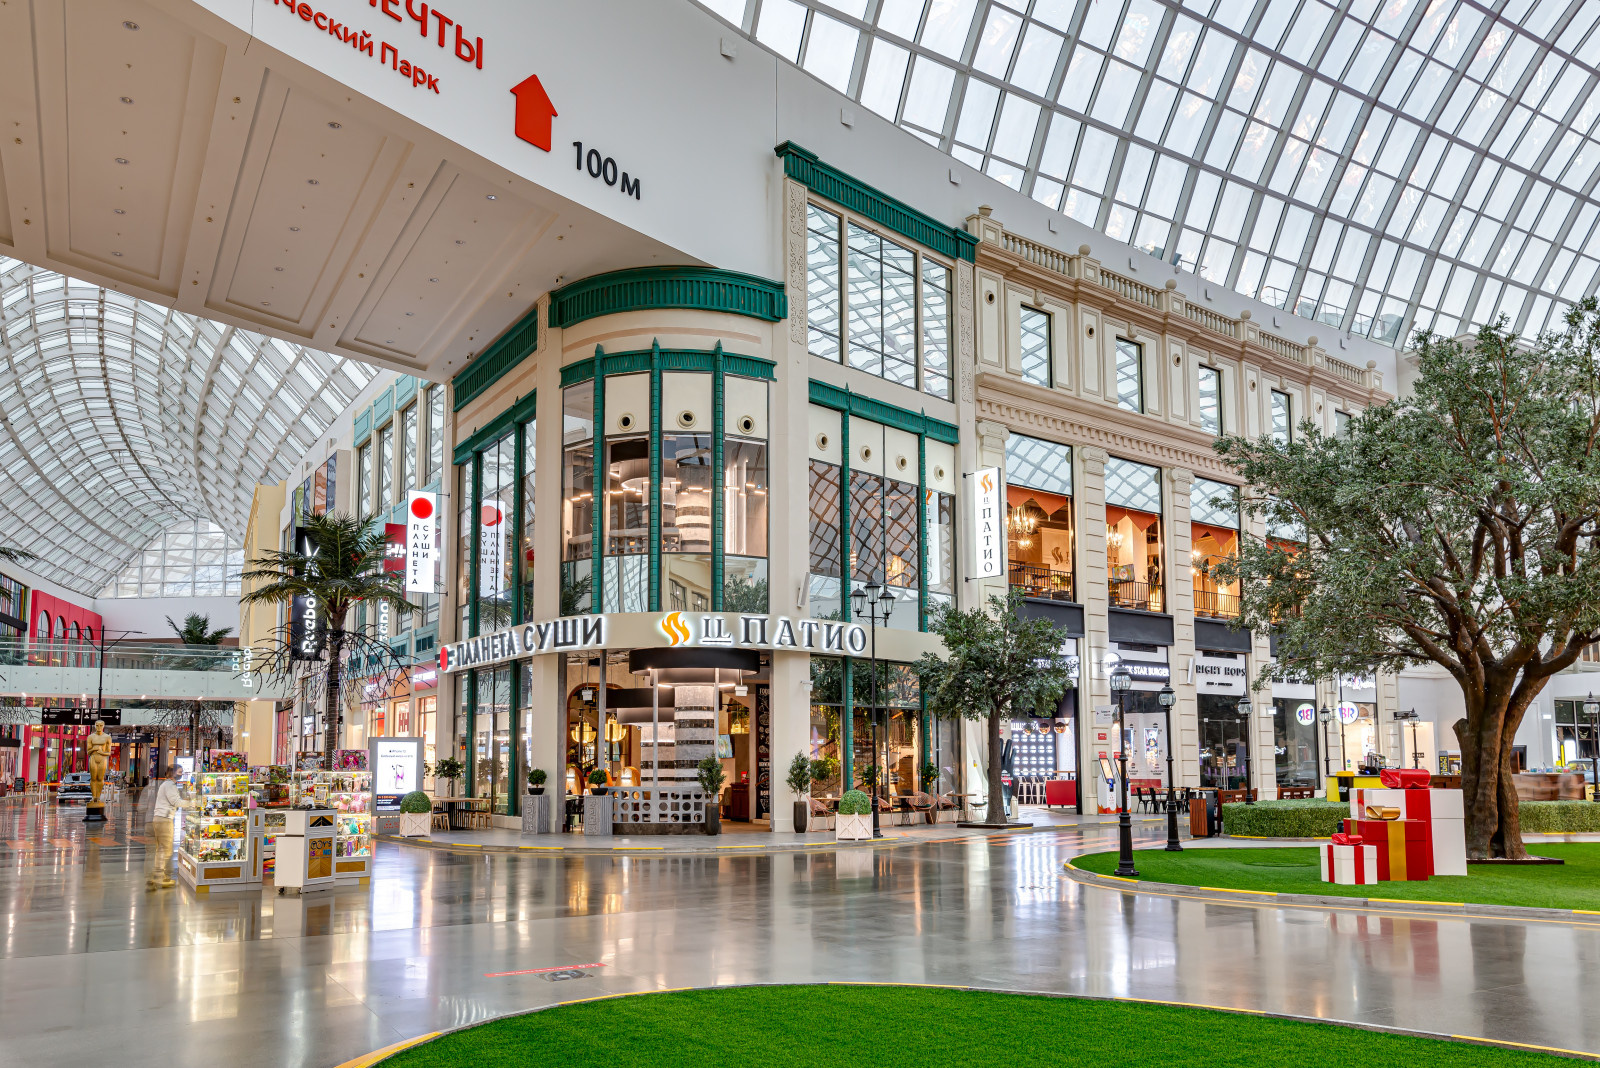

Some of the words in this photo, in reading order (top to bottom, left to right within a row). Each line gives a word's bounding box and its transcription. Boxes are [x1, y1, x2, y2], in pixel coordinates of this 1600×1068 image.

[272, 0, 374, 57] ческий
[381, 41, 440, 94] Парк
[369, 0, 483, 70] ЕЧТЫ
[573, 141, 618, 186] 100
[411, 523, 419, 585] ПЛАНЕТА
[421, 525, 430, 558] СУШИ
[982, 507, 993, 573] ПАТИО
[457, 631, 517, 667] ПЛАНЕТА
[523, 617, 604, 651] СУШИ
[741, 616, 867, 652] ПАТИО
[1134, 666, 1148, 676] STAR
[1148, 667, 1170, 677] BURGER
[1196, 665, 1221, 675] RIGHT
